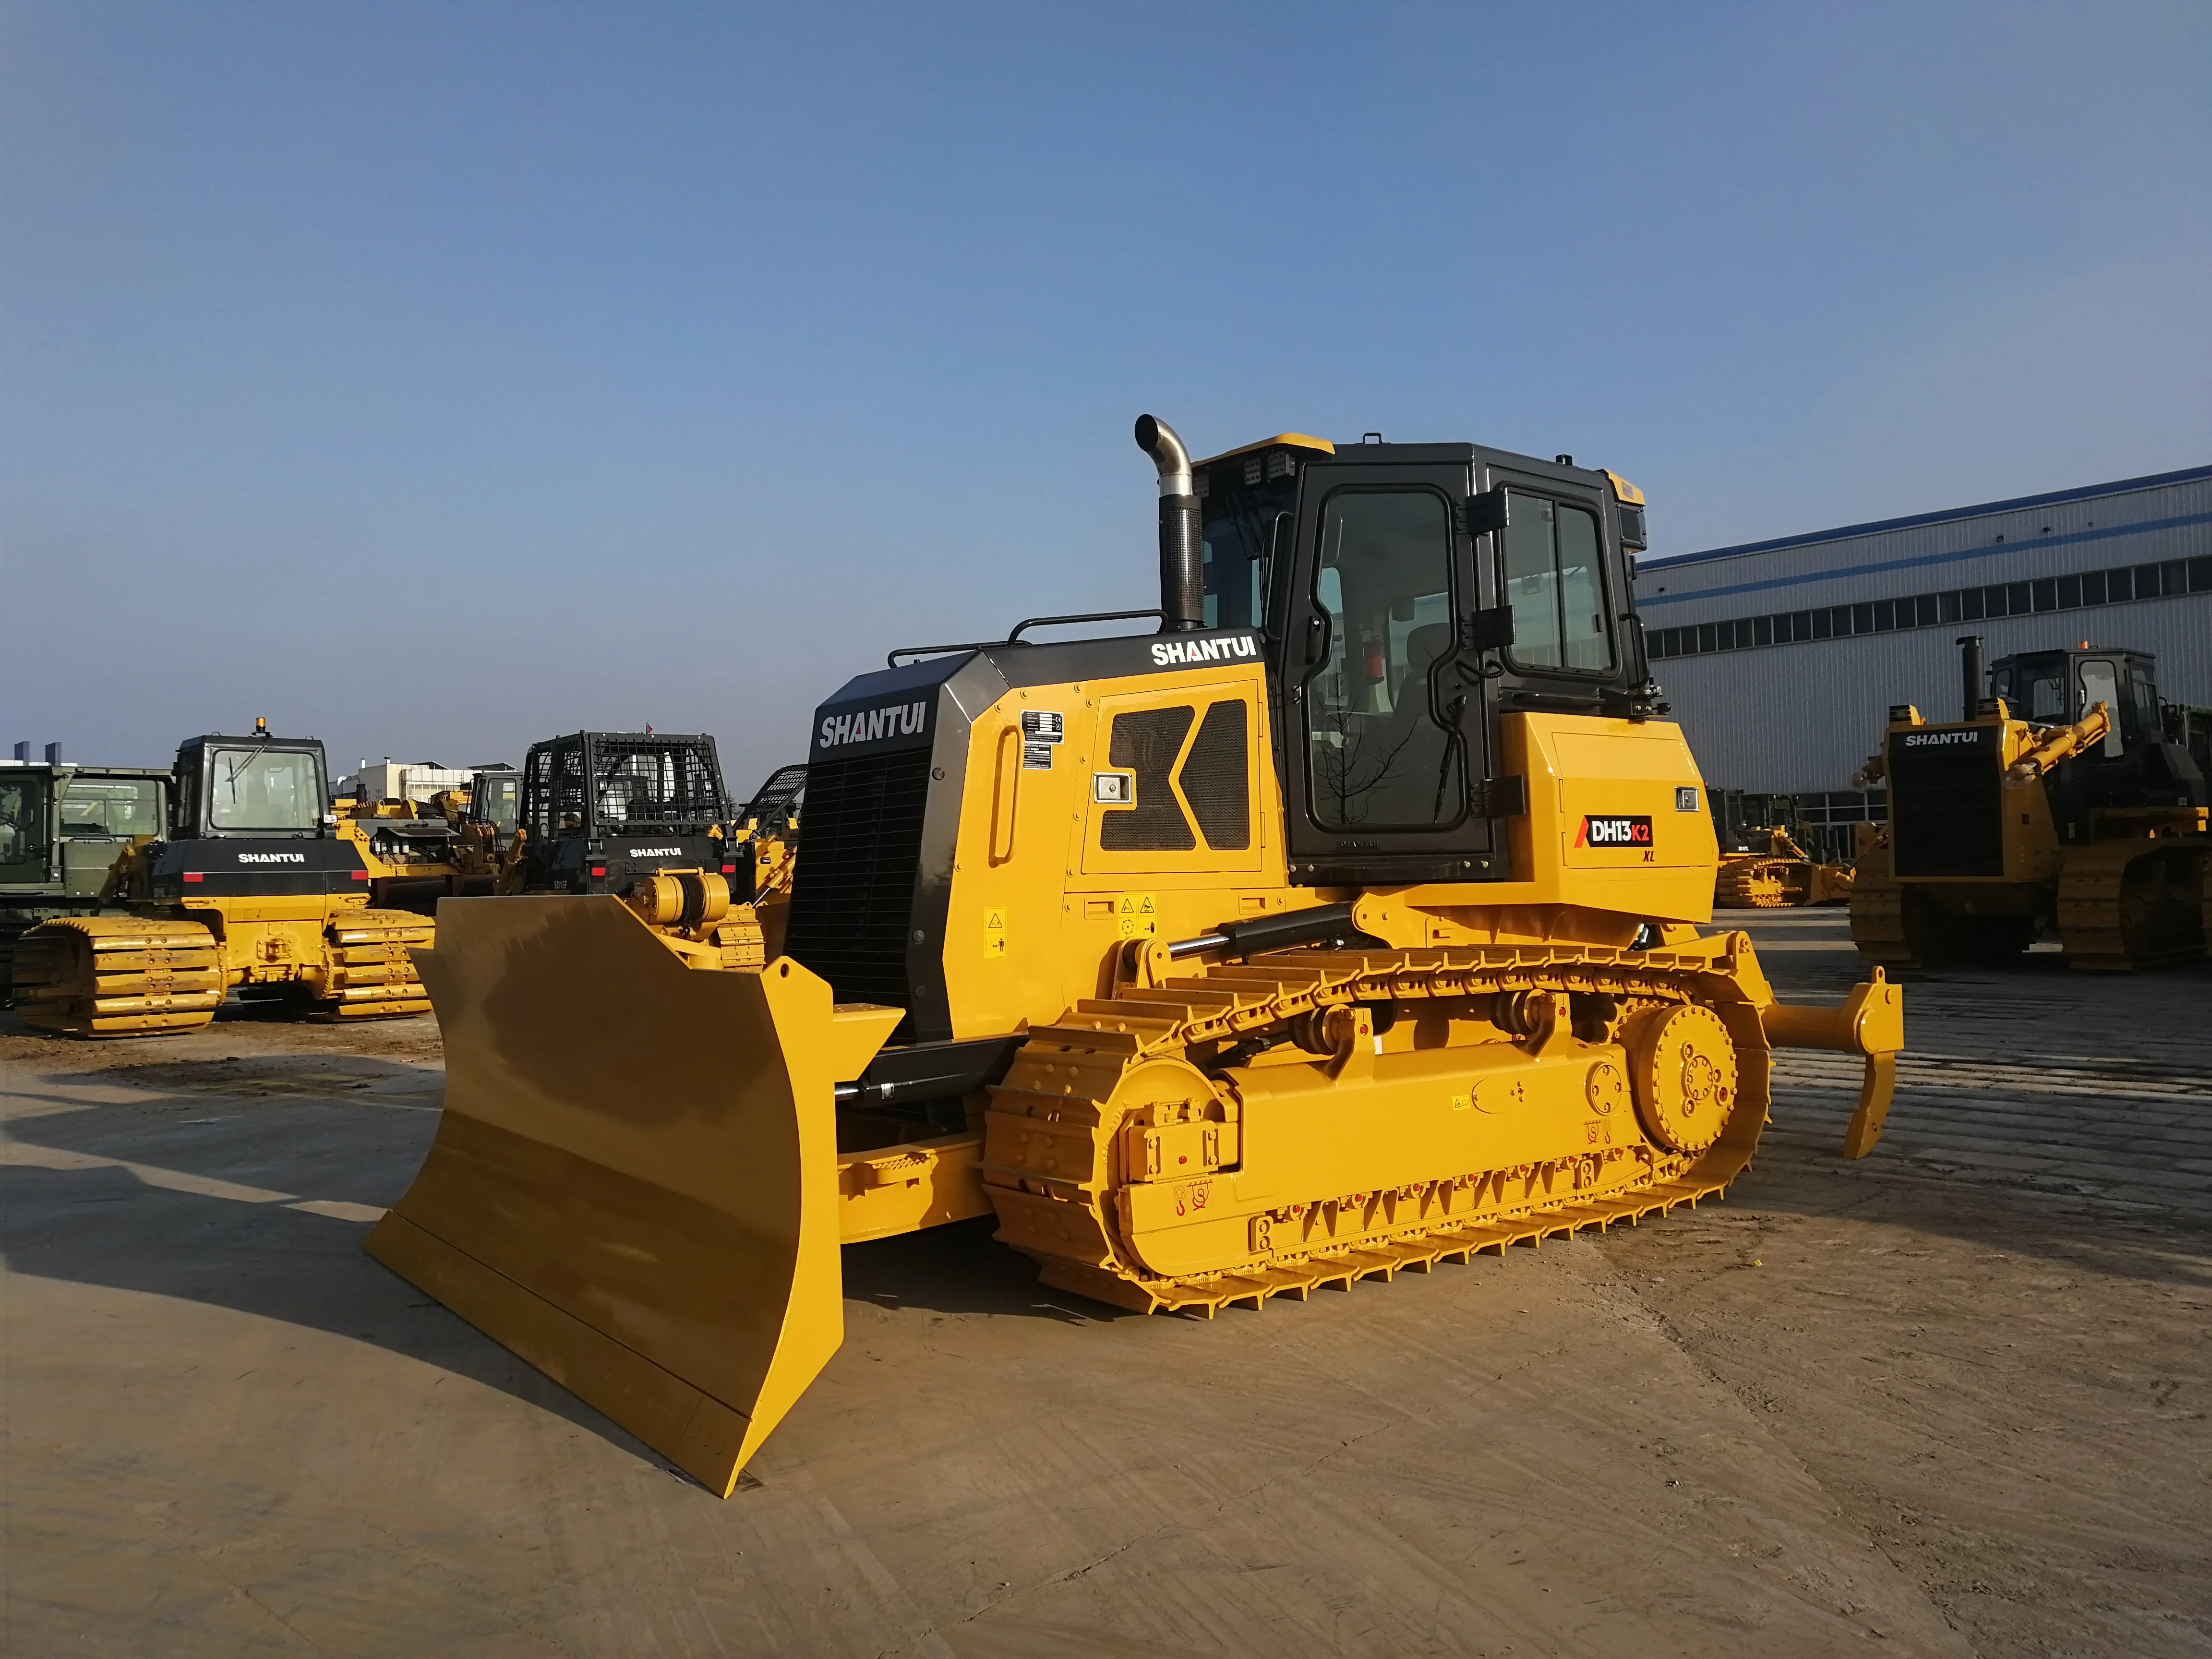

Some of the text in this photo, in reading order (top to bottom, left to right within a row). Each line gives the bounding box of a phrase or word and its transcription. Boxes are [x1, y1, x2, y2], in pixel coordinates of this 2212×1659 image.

[1151, 636, 1257, 665] SHANTUI
[819, 701, 926, 748] SHANTUI
[1906, 732, 1978, 746] SHANTUI
[238, 854, 305, 863] SHANTUI
[630, 848, 682, 857] SHANTUI
[1643, 850, 1655, 862] XL
[554, 880, 567, 890] SD16F
